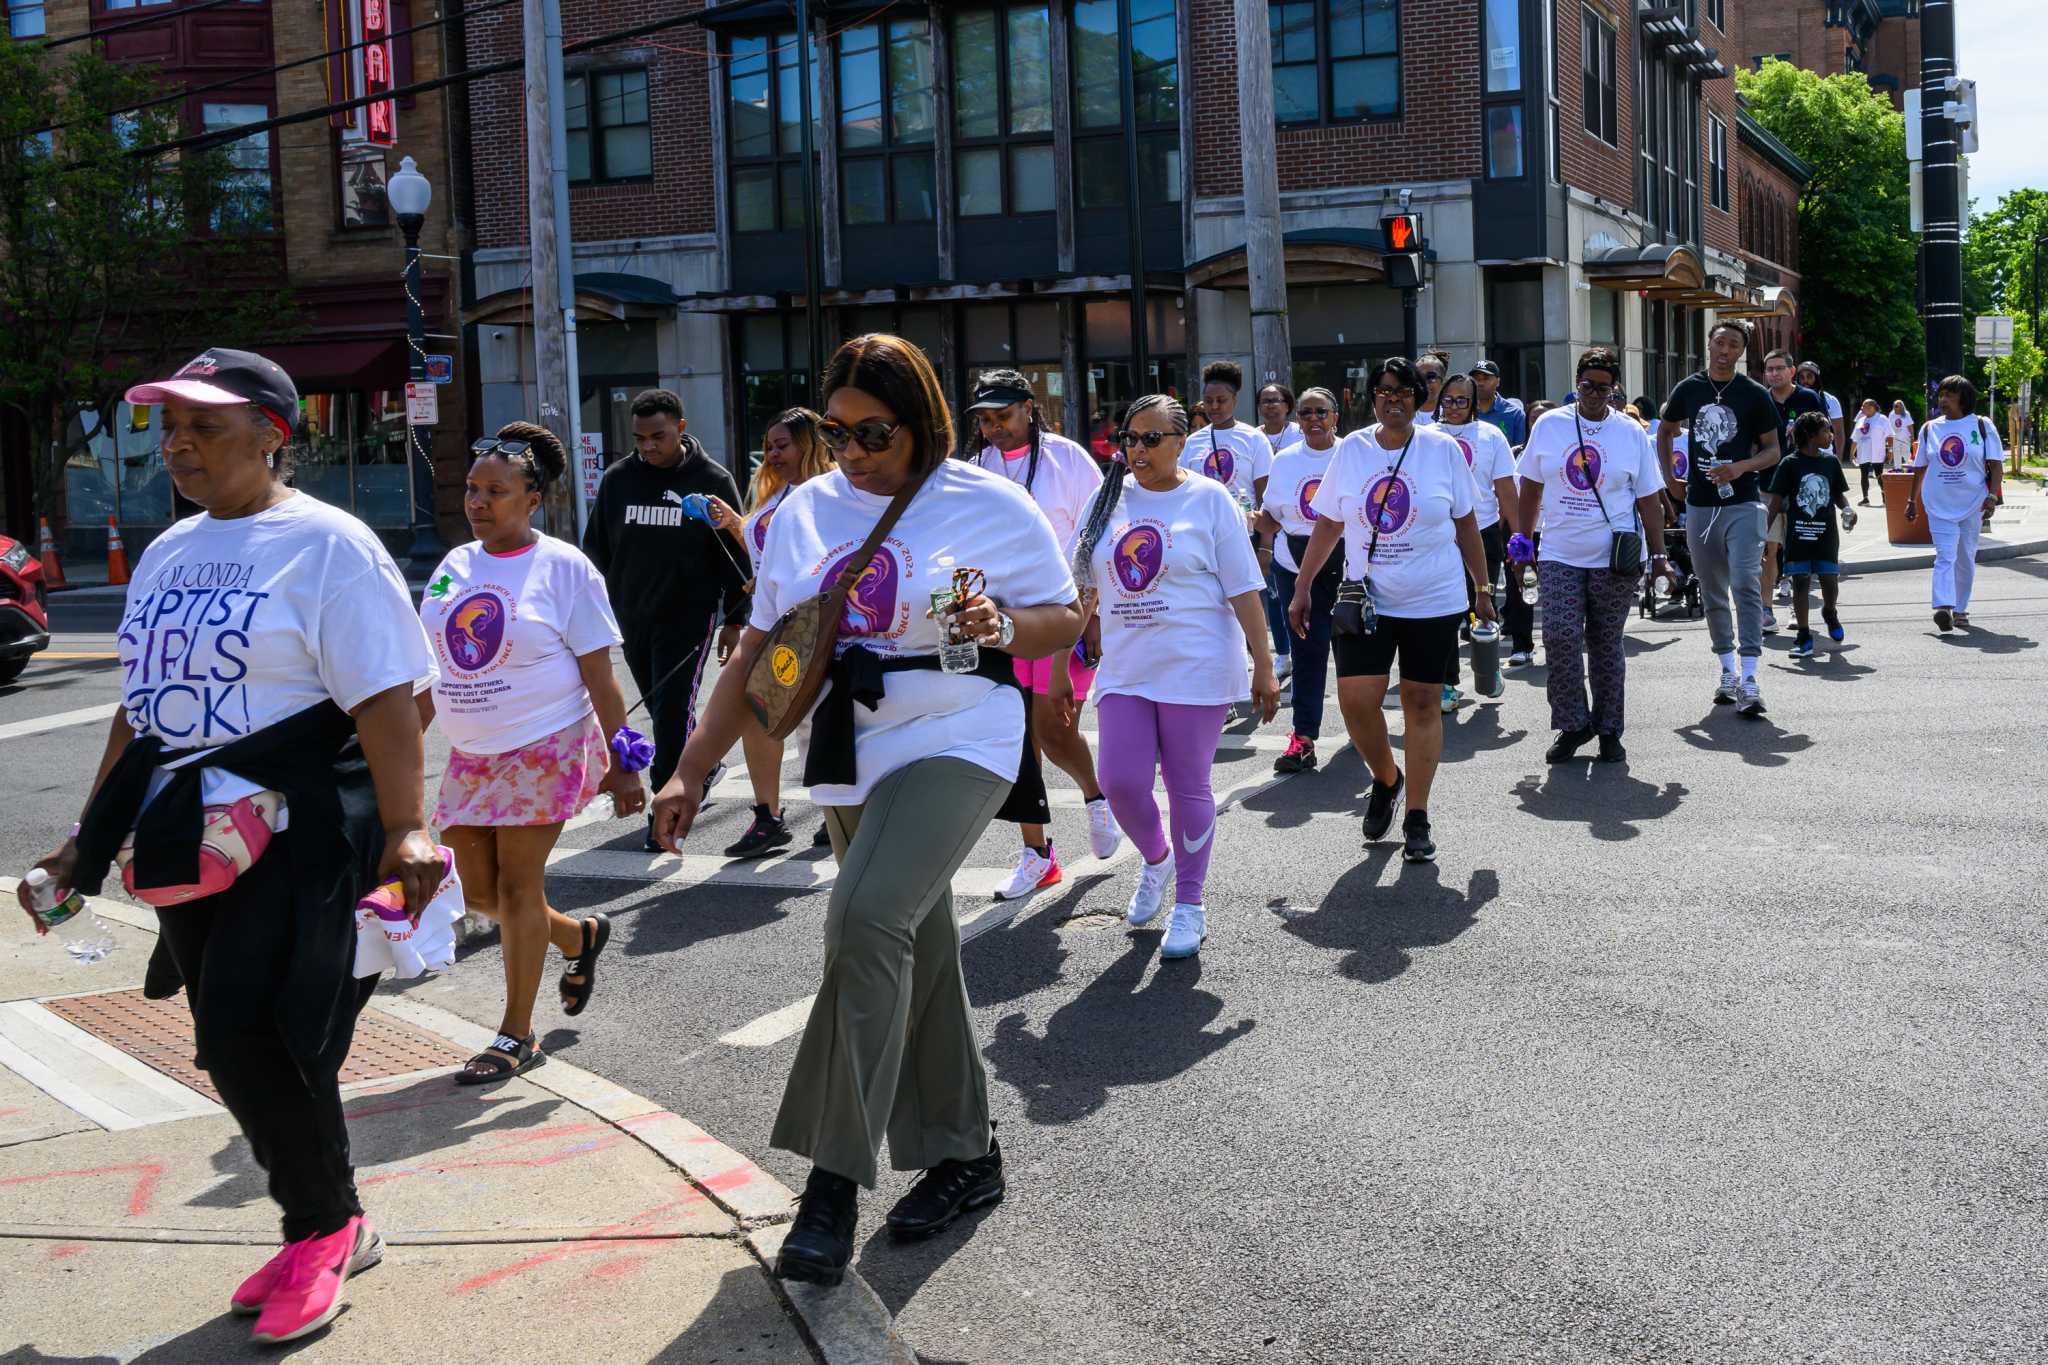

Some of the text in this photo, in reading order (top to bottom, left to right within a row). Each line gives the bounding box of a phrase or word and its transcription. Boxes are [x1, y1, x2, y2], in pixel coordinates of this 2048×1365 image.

[367, 0, 390, 132] BAR
[625, 505, 682, 526] PUMA
[153, 562, 254, 592] OLCONDA
[482, 583, 511, 598] MARCH
[124, 588, 269, 632] APTIST
